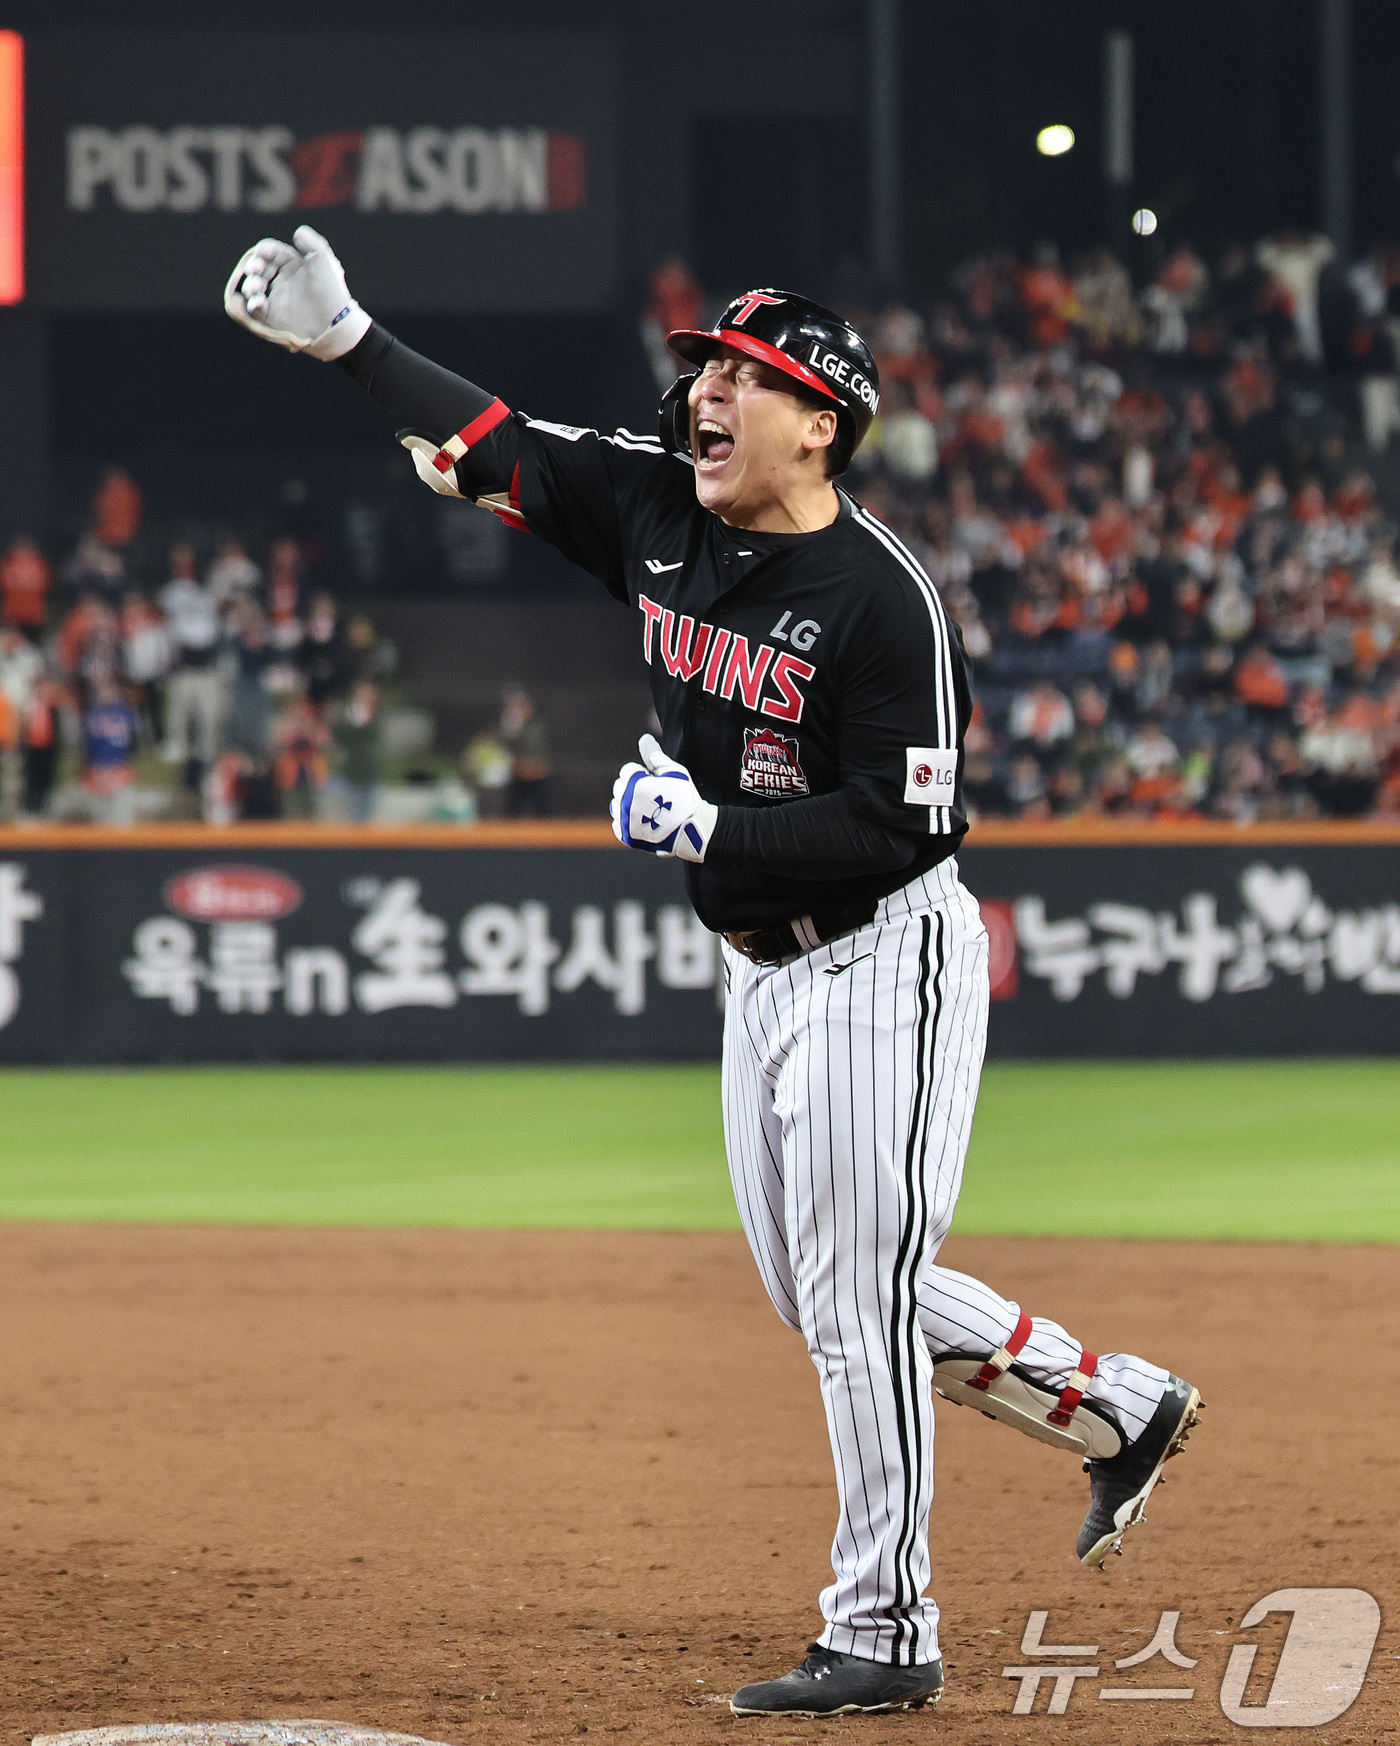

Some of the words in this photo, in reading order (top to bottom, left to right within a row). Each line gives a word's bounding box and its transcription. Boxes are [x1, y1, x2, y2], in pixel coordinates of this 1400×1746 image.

[731, 293, 787, 325] T
[808, 345, 880, 416] LGE.COM
[769, 610, 821, 651] LG
[639, 594, 816, 724] TWINS
[741, 769, 808, 793] SERIES
[747, 758, 798, 776] KOREAN
[936, 768, 953, 786] LG
[1015, 895, 1238, 1002] 누구나
